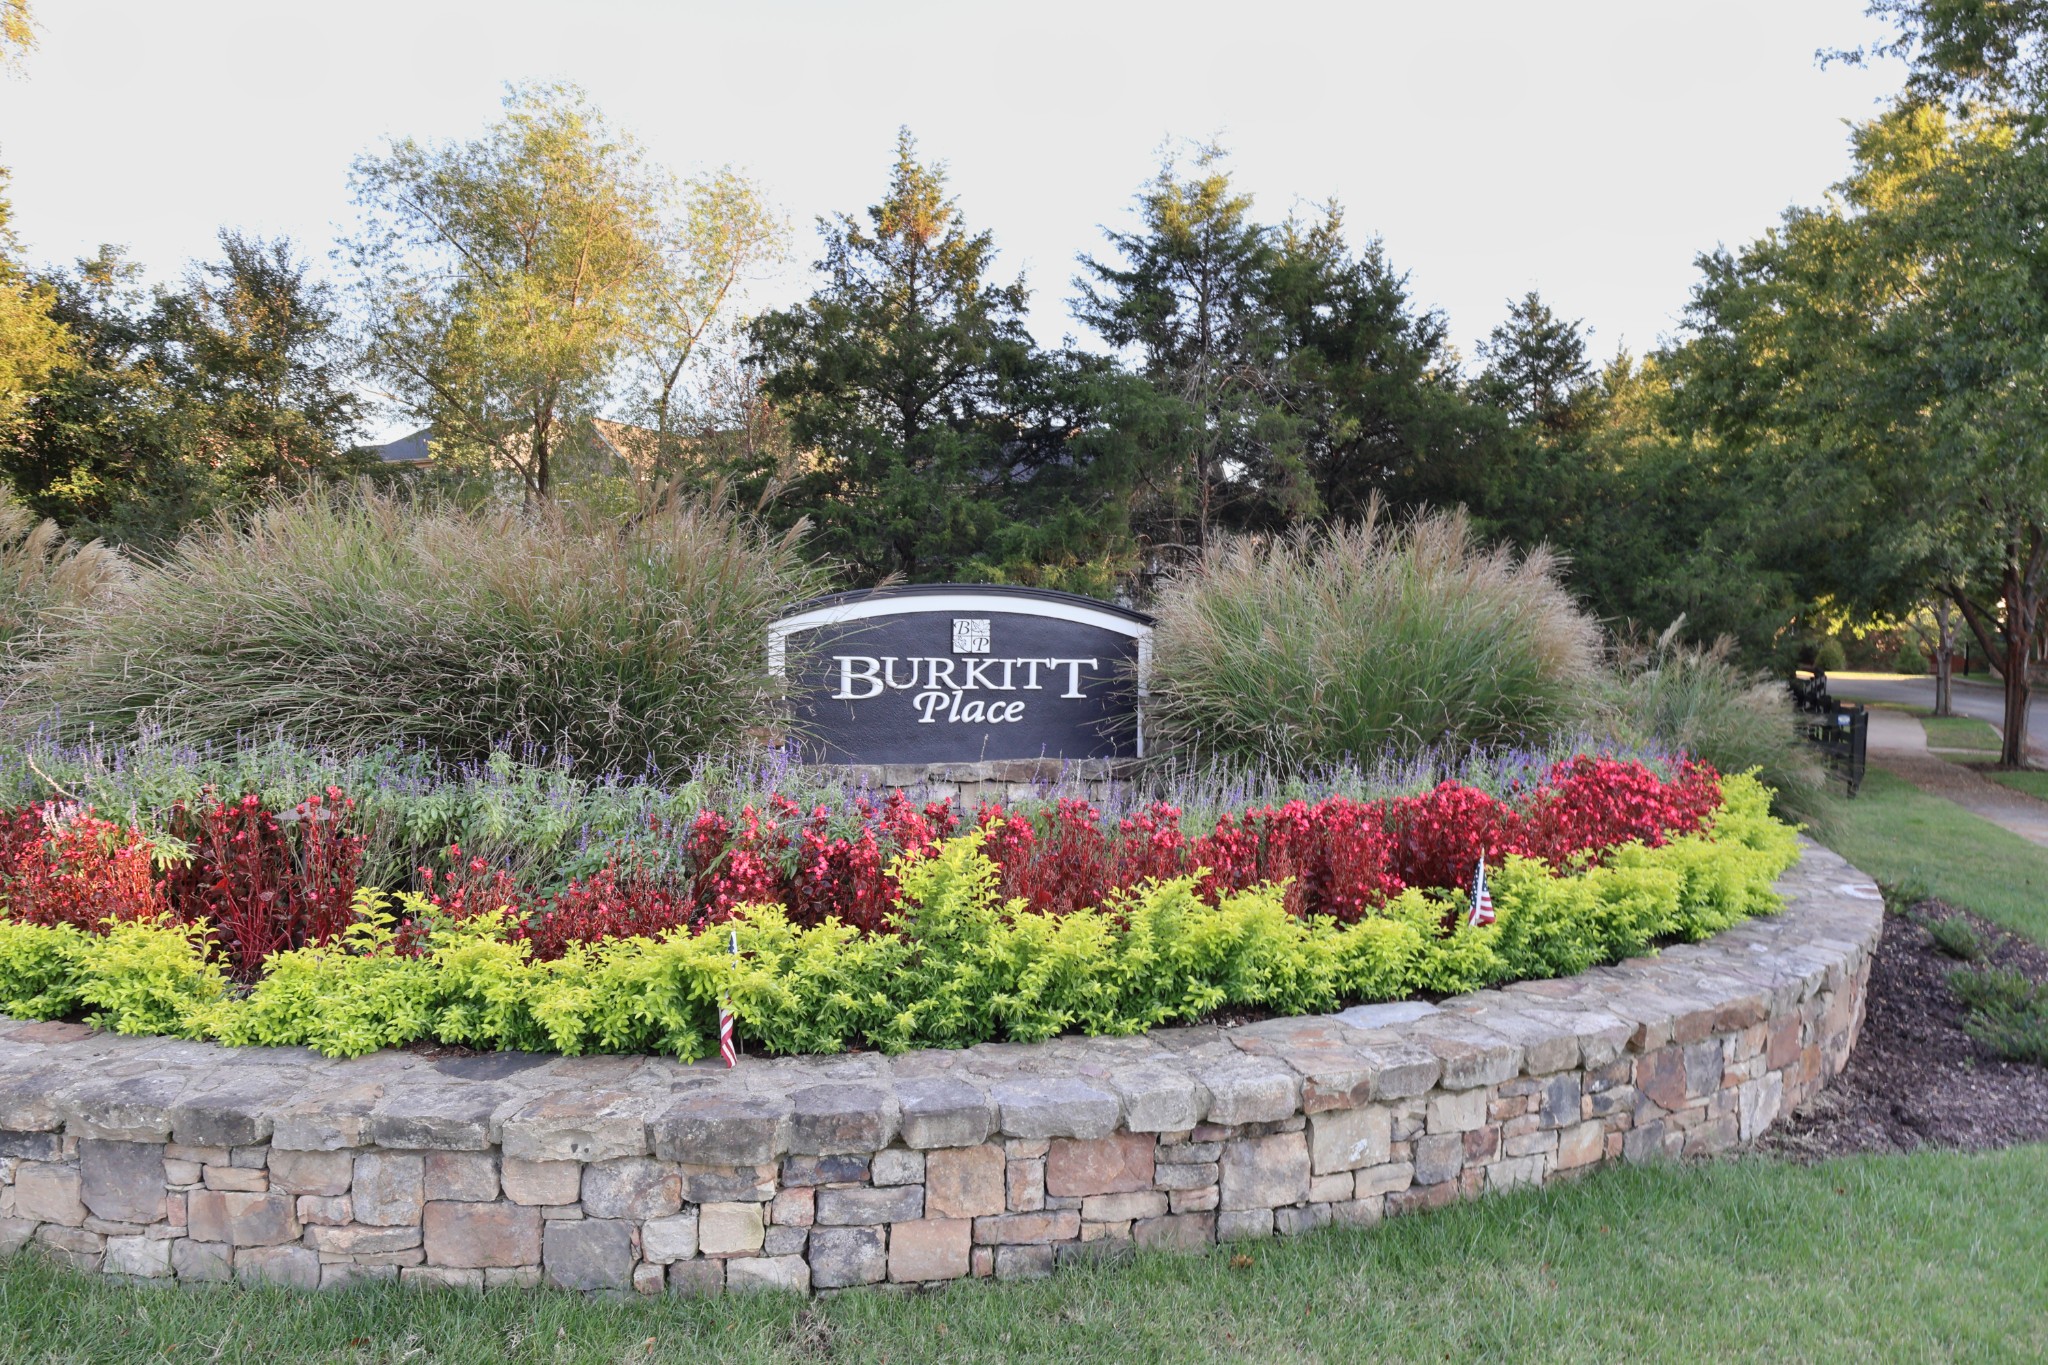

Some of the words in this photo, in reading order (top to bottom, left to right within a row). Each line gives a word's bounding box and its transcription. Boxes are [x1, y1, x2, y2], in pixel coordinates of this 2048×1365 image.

[953, 620, 970, 635] B
[972, 637, 989, 652] P
[831, 655, 1098, 699] BURKITT
[913, 690, 1025, 724] Place
